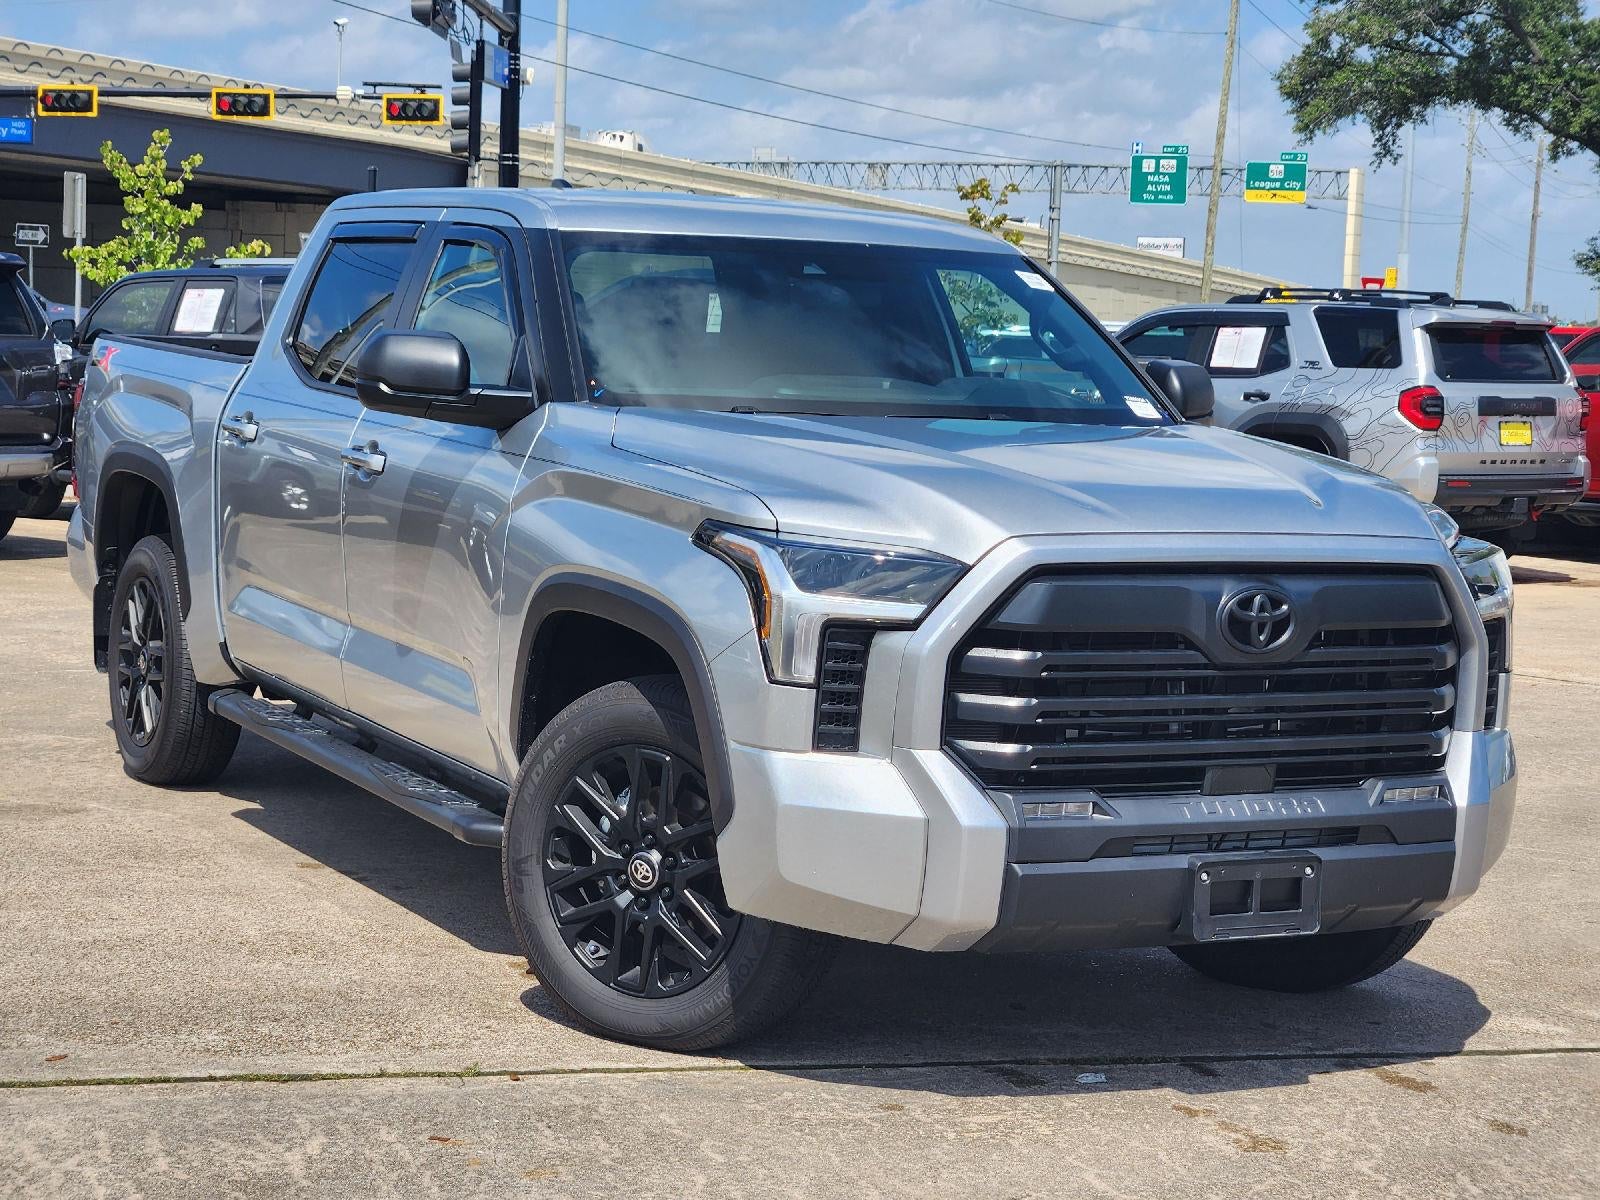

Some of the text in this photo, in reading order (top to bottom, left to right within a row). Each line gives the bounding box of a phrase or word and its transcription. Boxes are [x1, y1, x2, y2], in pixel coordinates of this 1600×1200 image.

[0, 126, 8, 137] y
[1147, 174, 1169, 182] NASA
[1250, 180, 1301, 190] League City
[1138, 241, 1161, 250] Holiday
[1168, 797, 1326, 820] TUNDRA
